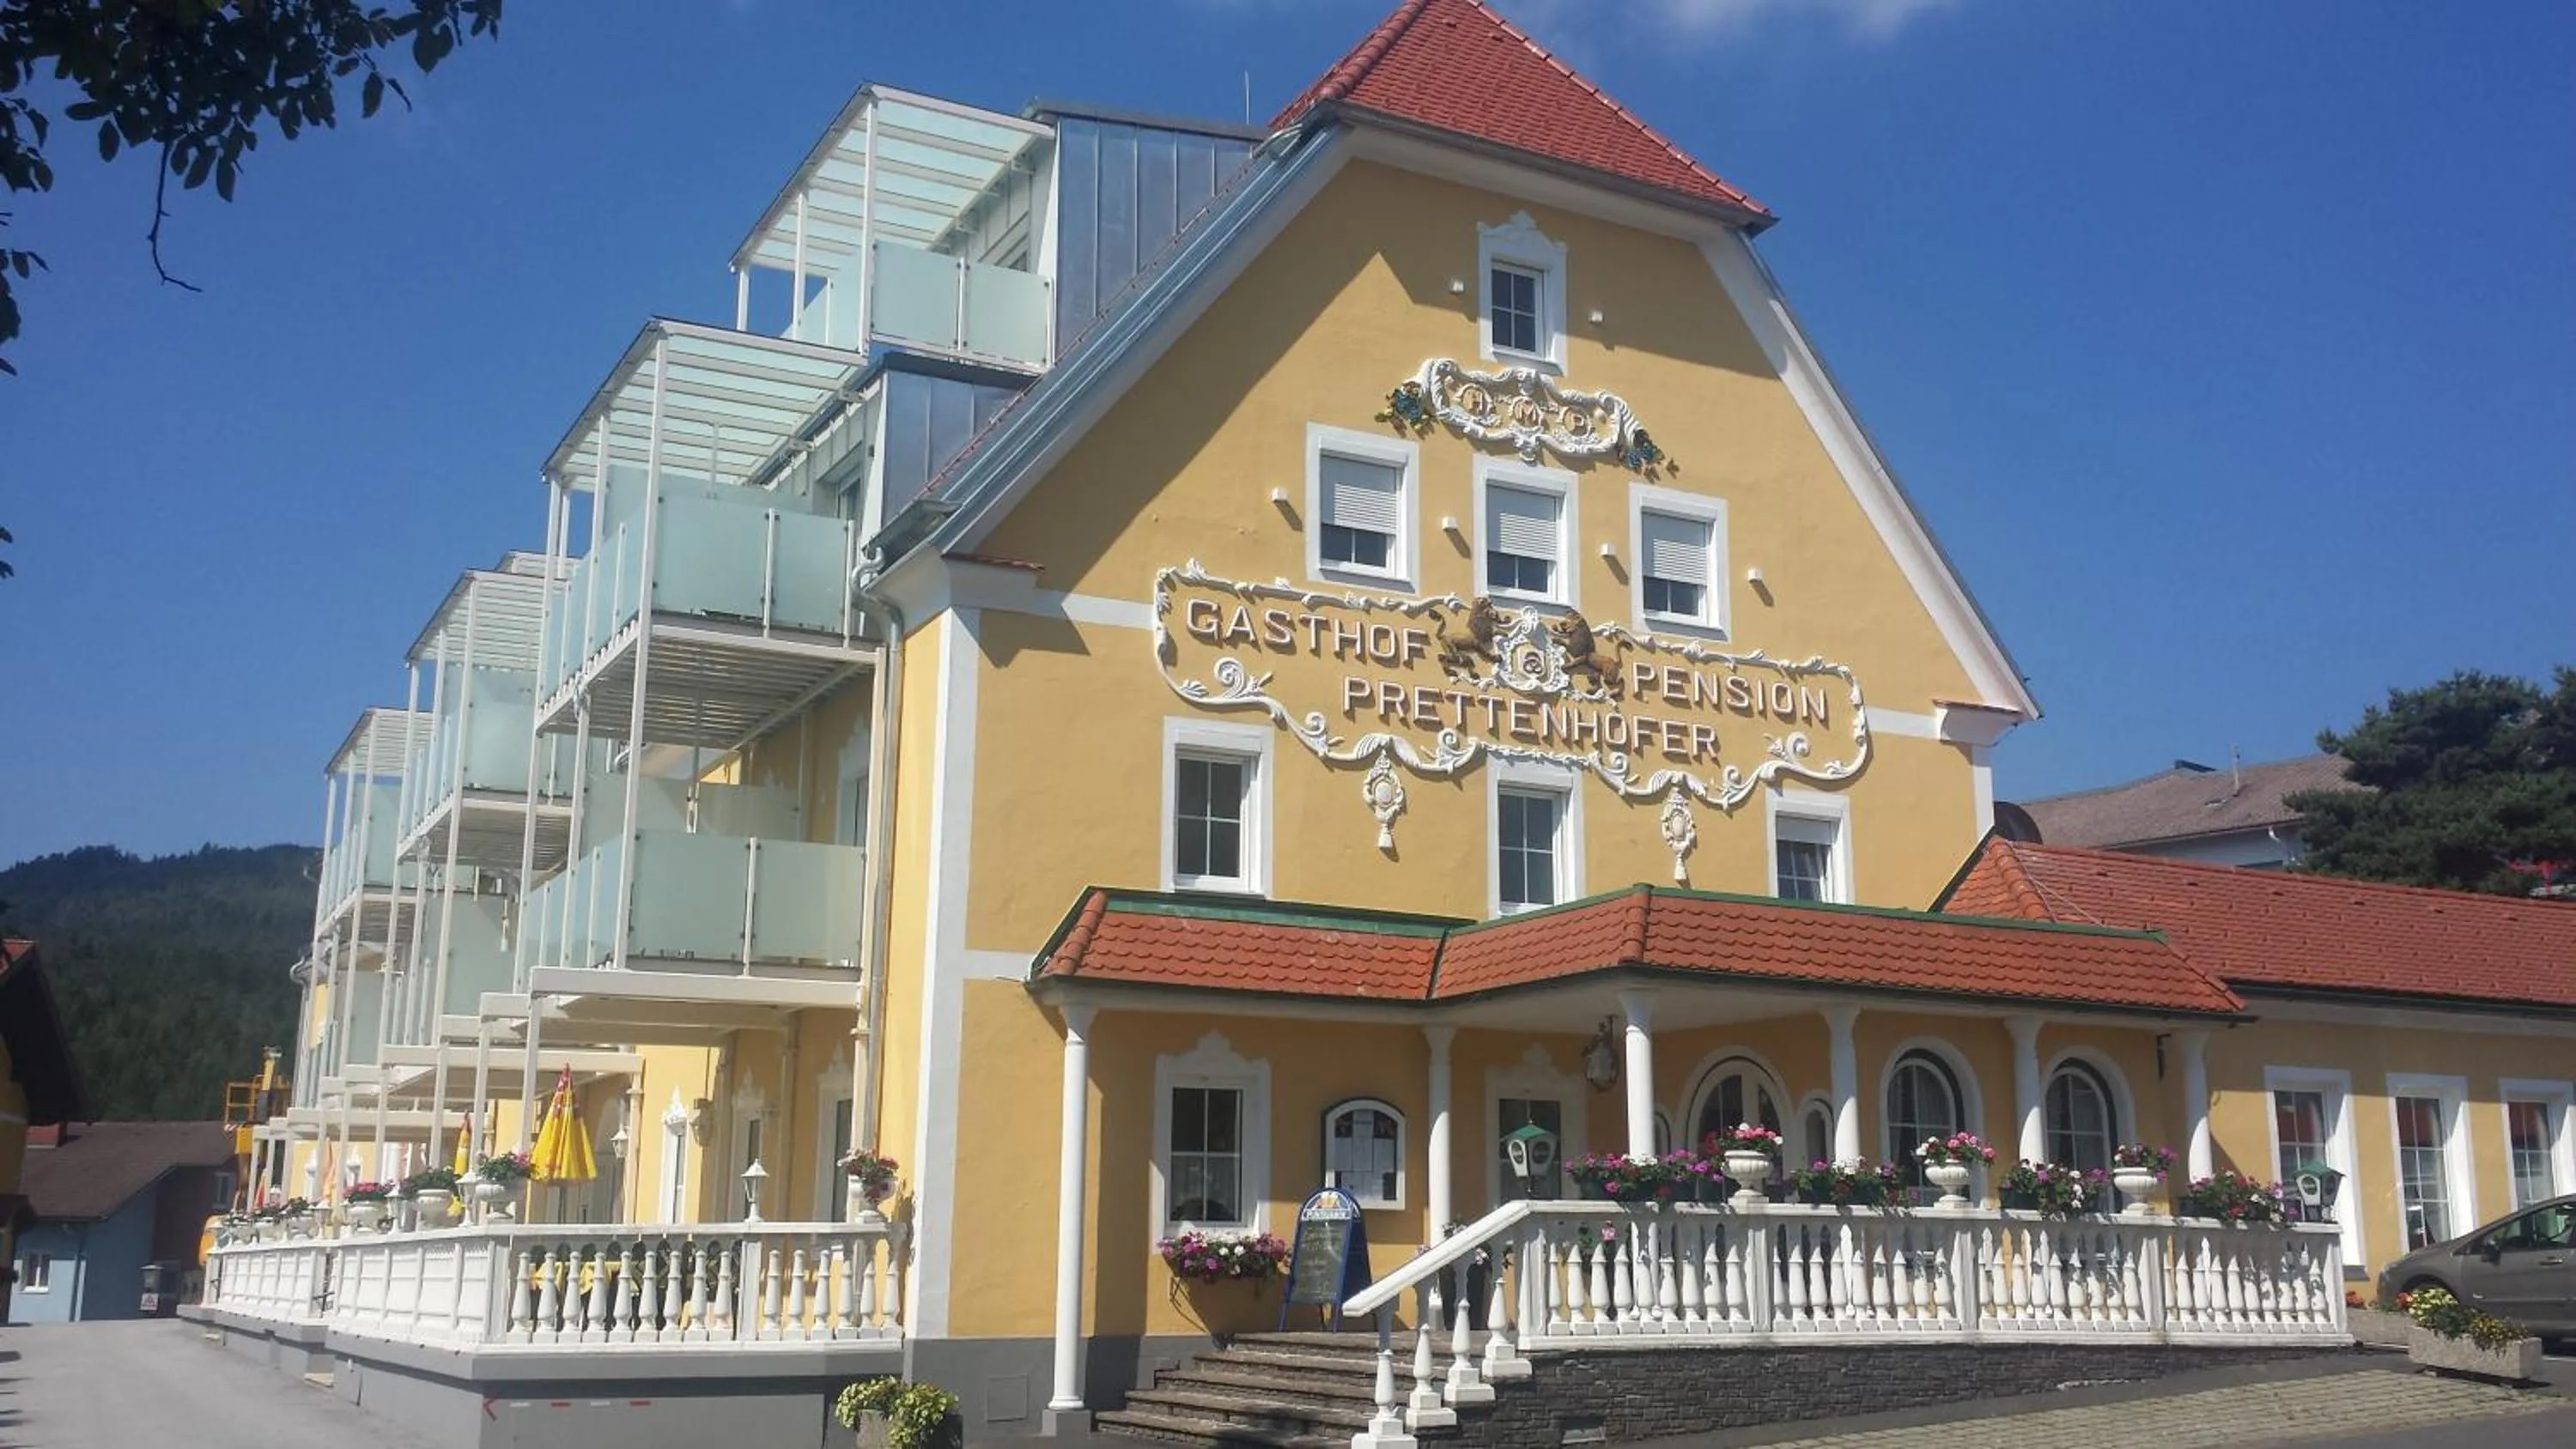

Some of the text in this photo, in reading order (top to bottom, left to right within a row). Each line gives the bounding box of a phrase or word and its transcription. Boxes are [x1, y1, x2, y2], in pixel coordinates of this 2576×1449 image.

[1187, 598, 1826, 722] GASTHOF PENSION
[1343, 675, 1718, 760] PRETTENHOFER
